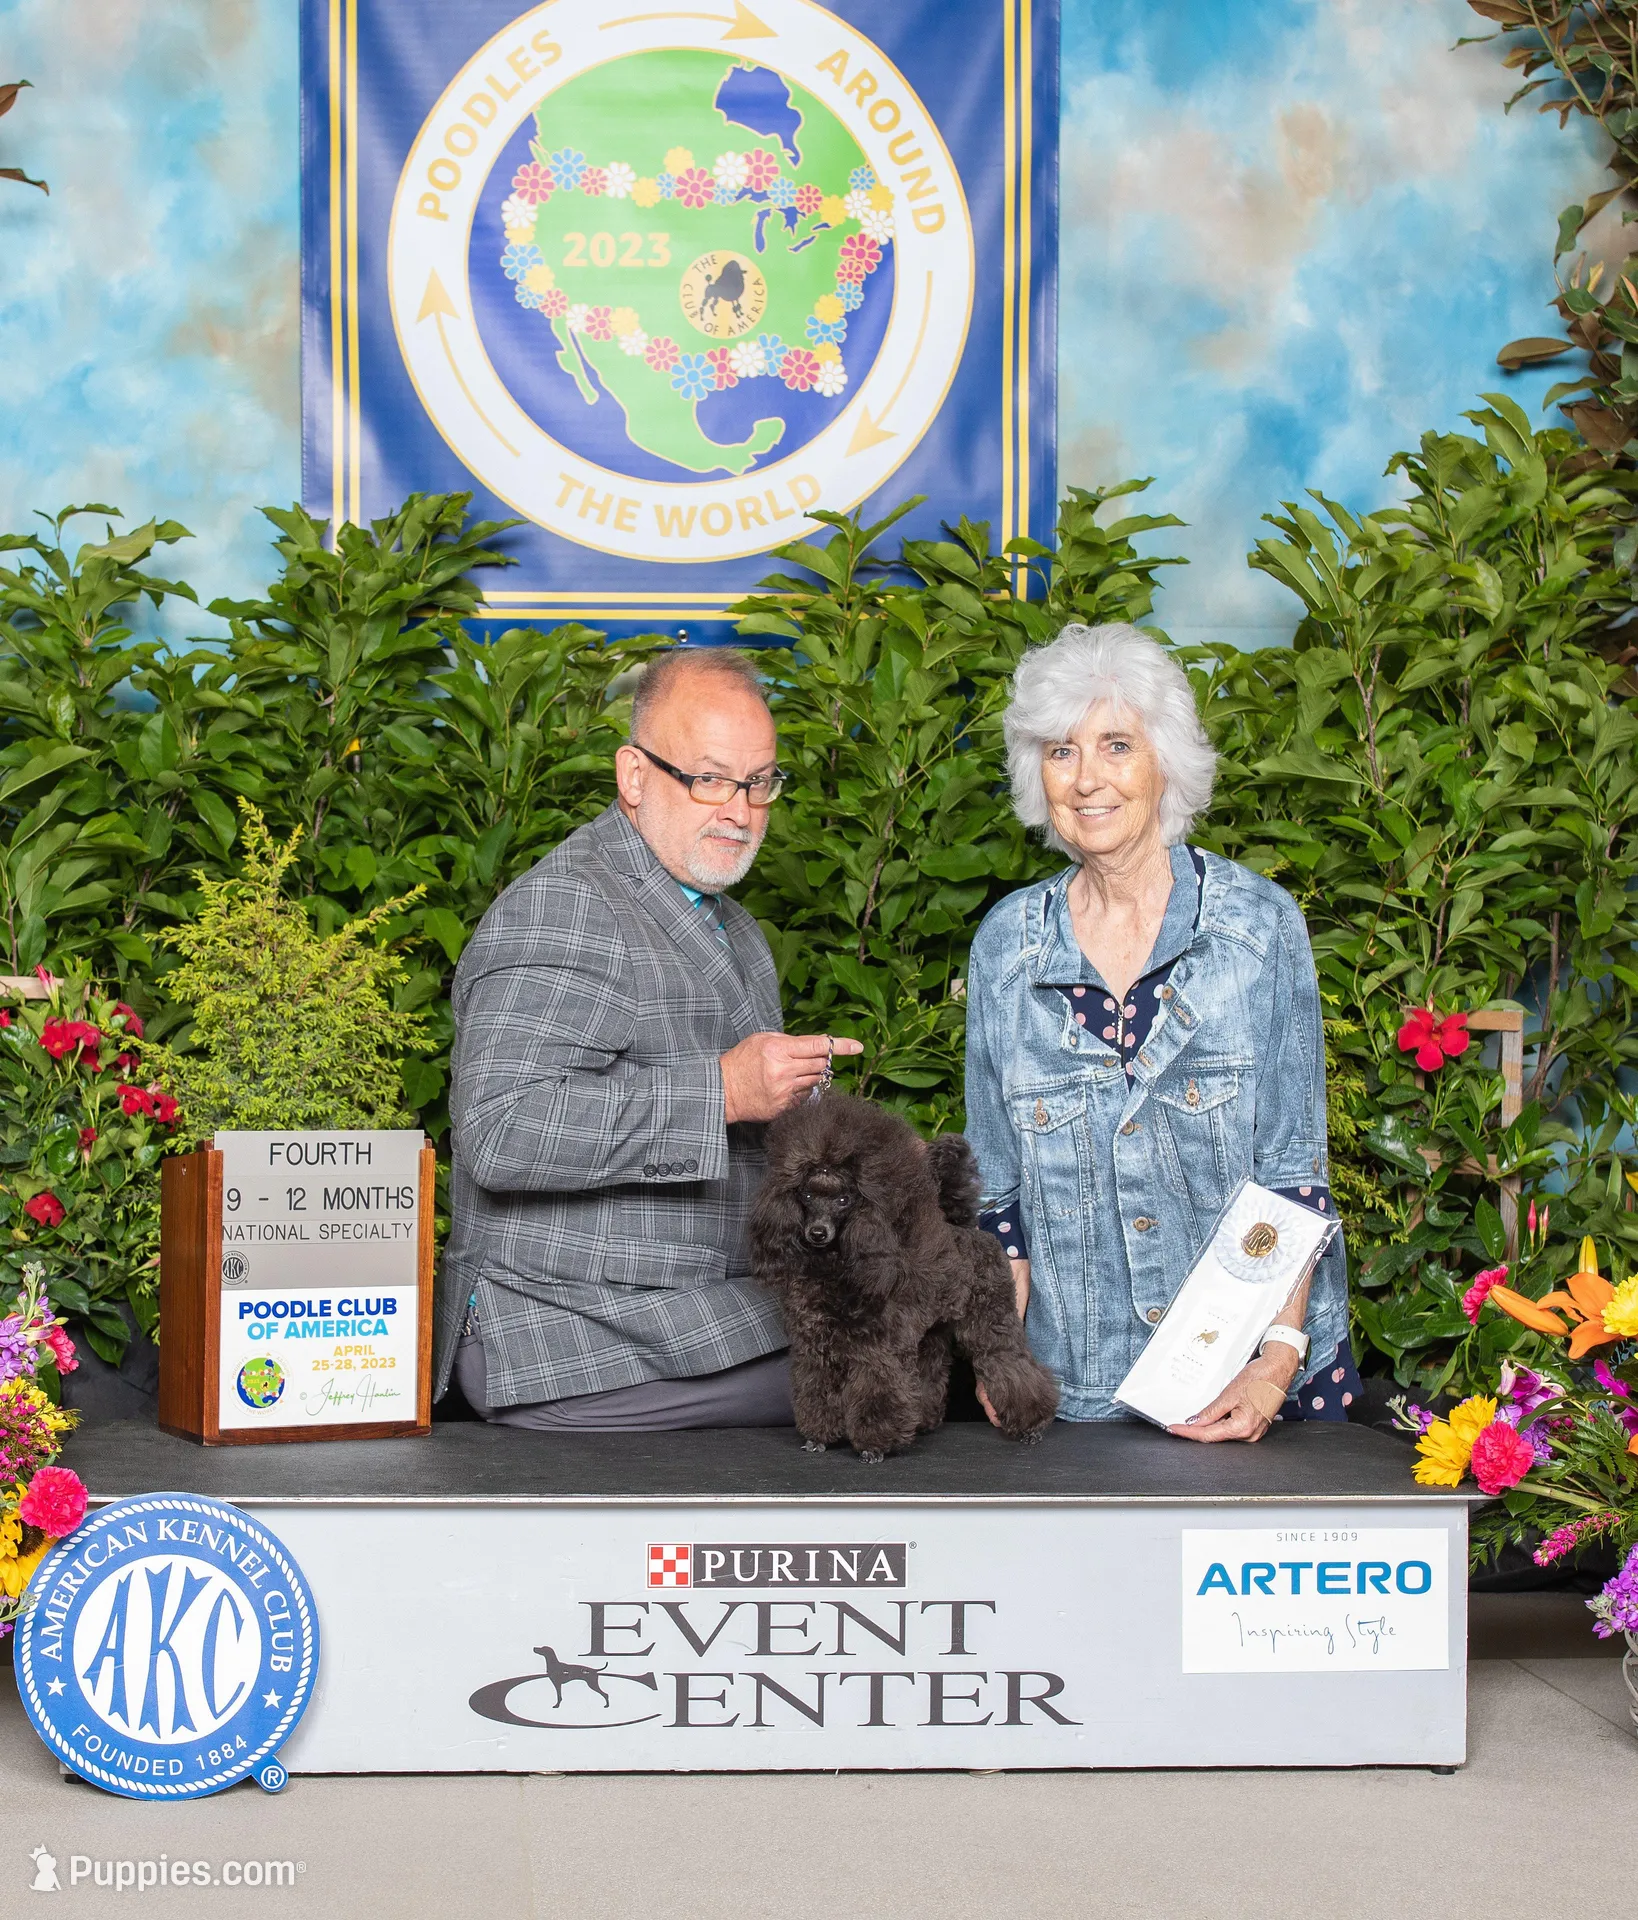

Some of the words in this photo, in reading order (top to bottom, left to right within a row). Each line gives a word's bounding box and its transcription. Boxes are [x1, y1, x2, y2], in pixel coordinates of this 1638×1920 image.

[416, 29, 563, 222] POODLES
[816, 48, 946, 235] AROUND
[562, 231, 671, 267] 2023
[692, 254, 718, 273] THE
[682, 283, 699, 319] CLUB
[727, 278, 765, 336] AMERICA
[704, 322, 720, 335] OF
[554, 473, 639, 533] THE
[654, 473, 823, 539] WORLD
[270, 1142, 372, 1165] FOURTH
[226, 1187, 242, 1211] 9
[286, 1187, 307, 1210] 12
[323, 1186, 415, 1210] MONTHS
[222, 1224, 310, 1241] NATIONAL
[319, 1223, 414, 1239] SPECIALTY
[238, 1299, 332, 1320] POODLE
[337, 1297, 397, 1316] CLUB
[247, 1321, 280, 1340] OF
[284, 1318, 389, 1339] AMERICA
[312, 1358, 357, 1371] 25-28,
[360, 1357, 397, 1369] 2023
[333, 1345, 375, 1356] APRIL
[1276, 1532, 1317, 1542] SINCE
[1323, 1532, 1359, 1542] 1909
[701, 1549, 899, 1583] PURINA
[1196, 1561, 1432, 1596] ARTERO
[40, 1521, 148, 1662] AMERICAN
[157, 1518, 271, 1589] KENNEL
[263, 1590, 294, 1673] CLUB
[577, 1600, 997, 1657] EVENT
[1231, 1611, 1334, 1655] Inspiring
[1345, 1613, 1397, 1655] Style
[82, 1561, 246, 1739] AKC
[468, 1670, 1084, 1729] CENTER
[71, 1723, 184, 1776] FOUNDED
[196, 1734, 248, 1770] 1884
